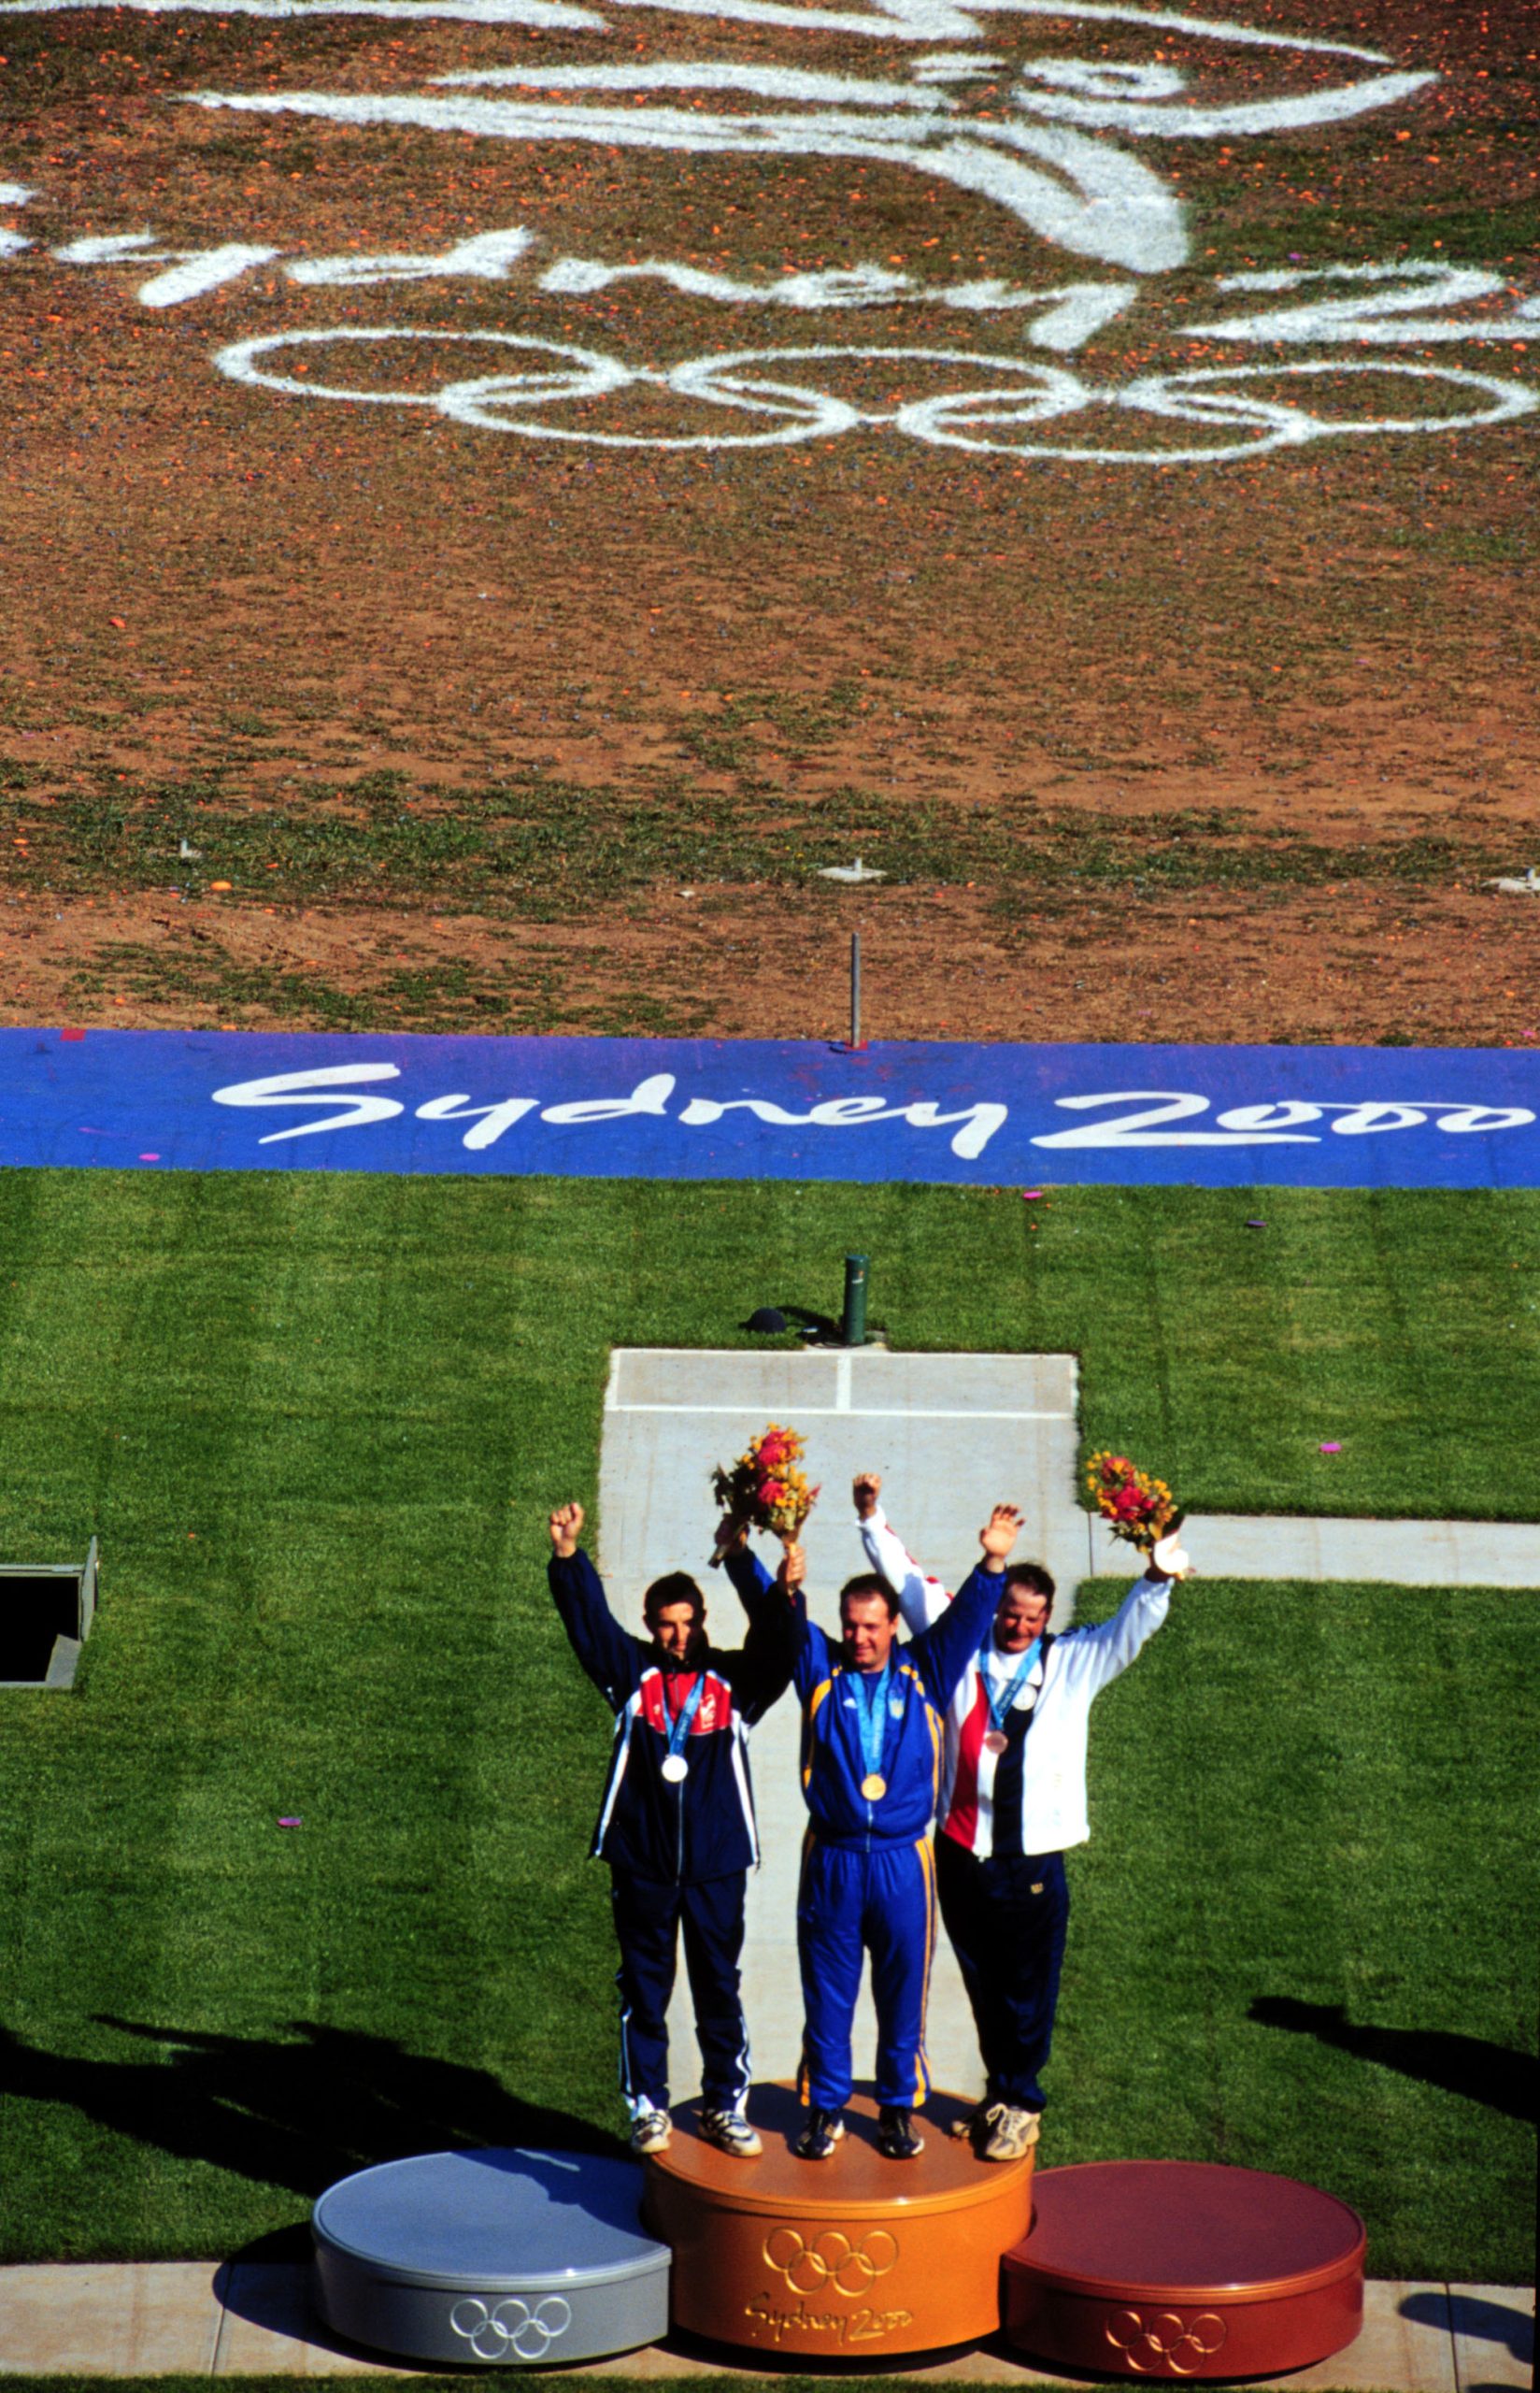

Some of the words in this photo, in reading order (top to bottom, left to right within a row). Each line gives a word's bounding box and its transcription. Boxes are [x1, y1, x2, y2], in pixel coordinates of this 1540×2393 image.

[0, 182, 1137, 351] ydney
[211, 1063, 1008, 1159] Sydney
[1030, 1091, 1536, 1149] 2000
[745, 2292, 848, 2346] Sydney
[848, 2307, 913, 2343] 2000
